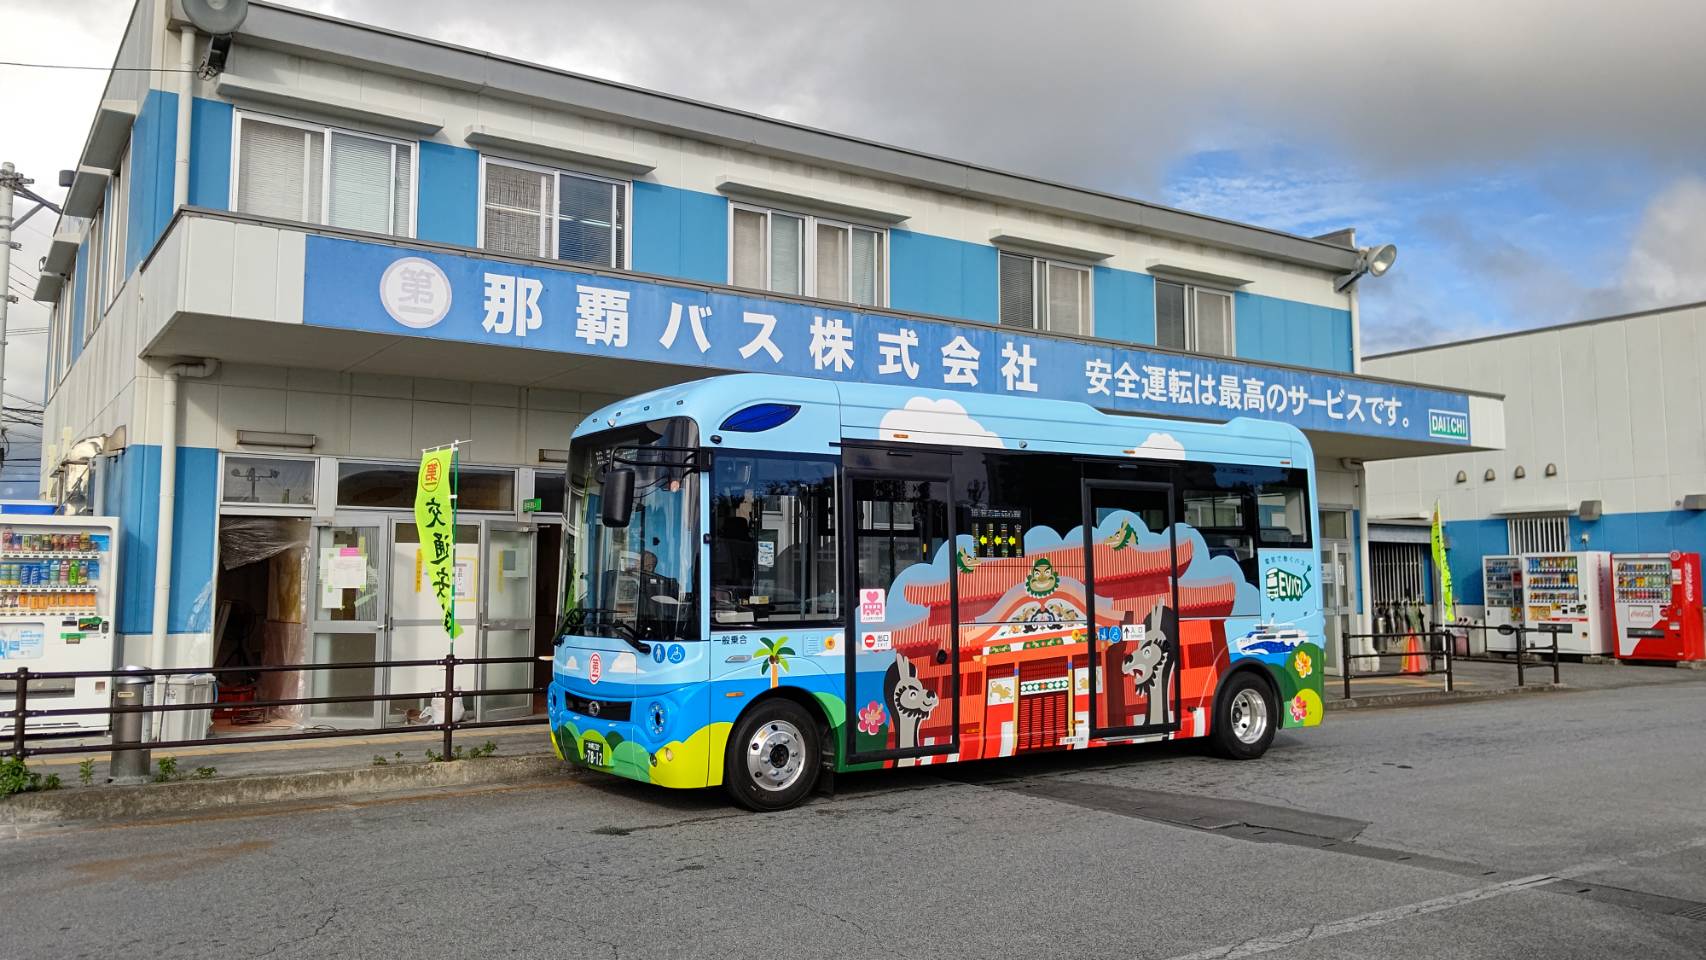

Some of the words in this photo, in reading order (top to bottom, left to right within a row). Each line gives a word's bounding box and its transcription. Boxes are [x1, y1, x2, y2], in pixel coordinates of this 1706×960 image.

[482, 272, 1038, 393] 那覇バス株式会社
[1084, 358, 1409, 428] 安全運転は最高のサービスです。
[713, 634, 747, 645] 一般乗合
